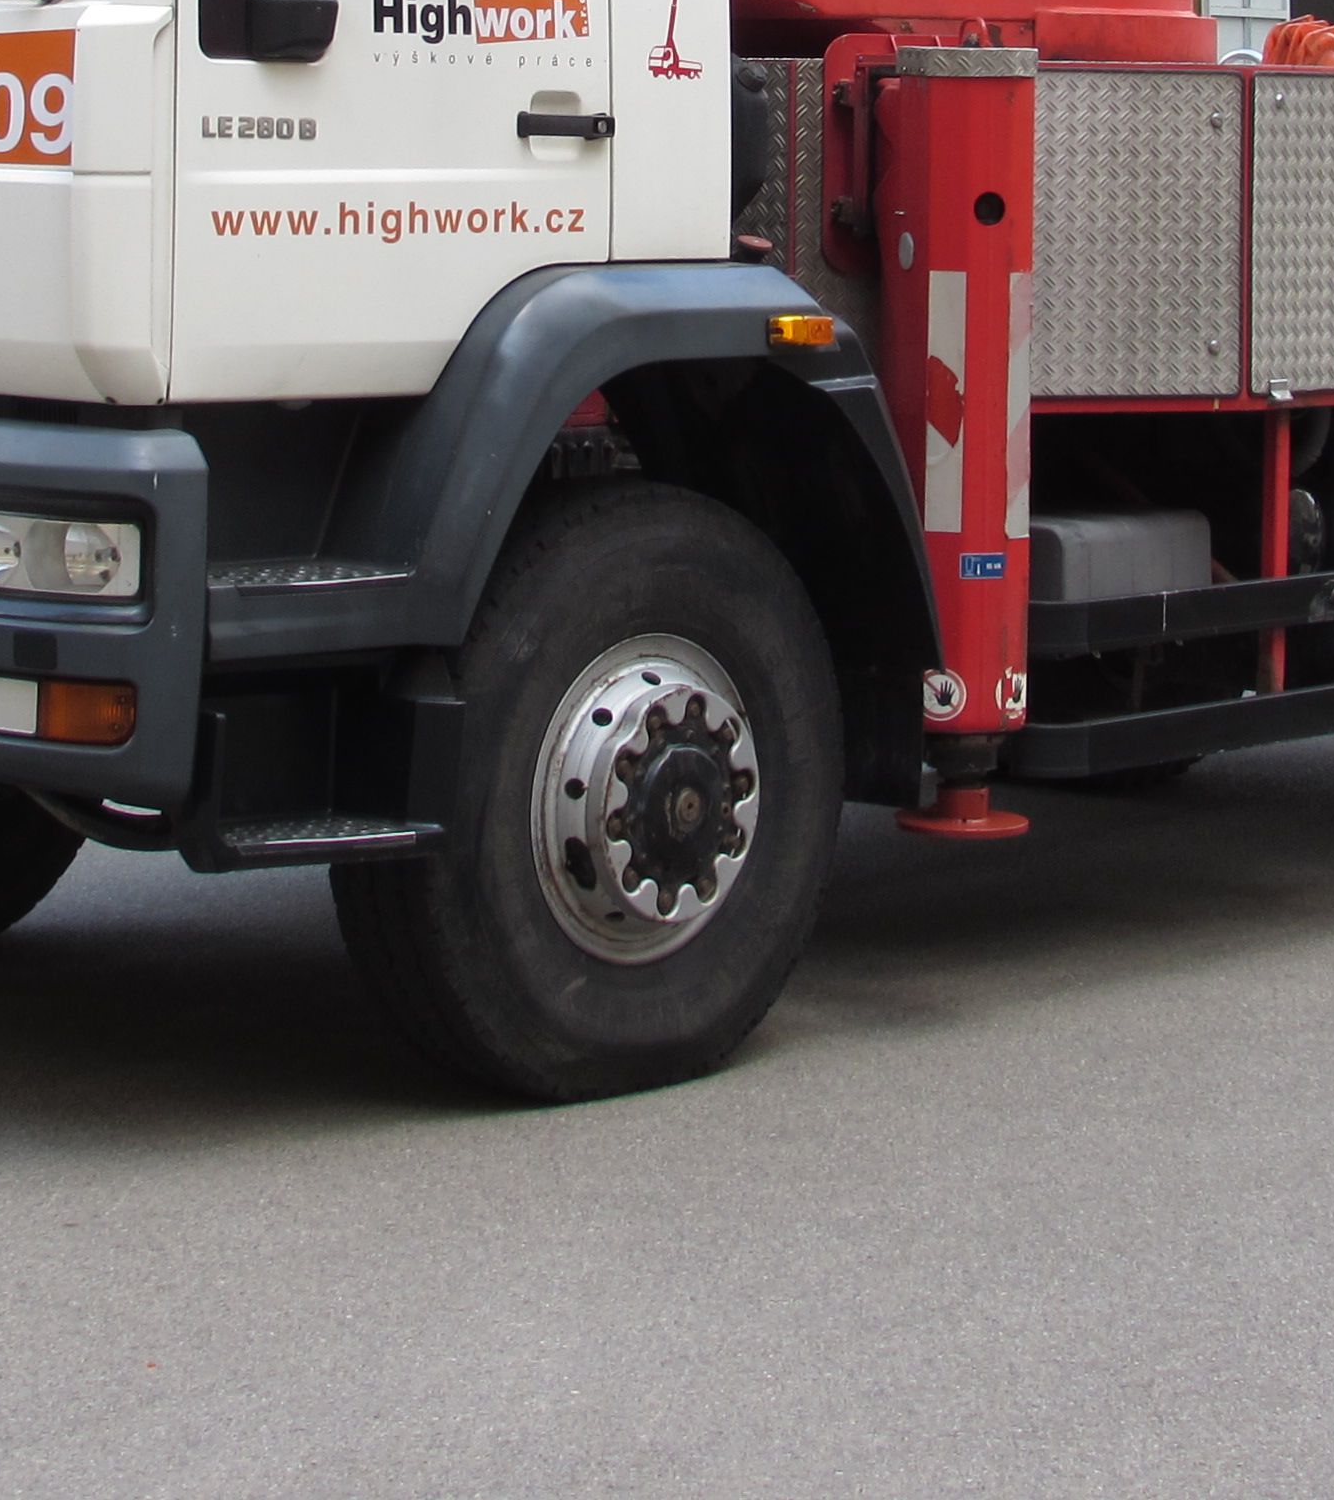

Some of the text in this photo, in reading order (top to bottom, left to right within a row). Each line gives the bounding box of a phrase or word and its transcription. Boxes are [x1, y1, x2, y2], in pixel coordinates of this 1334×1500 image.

[373, 50, 594, 68] výškové práce
[211, 202, 586, 244] www.highwork.cz
